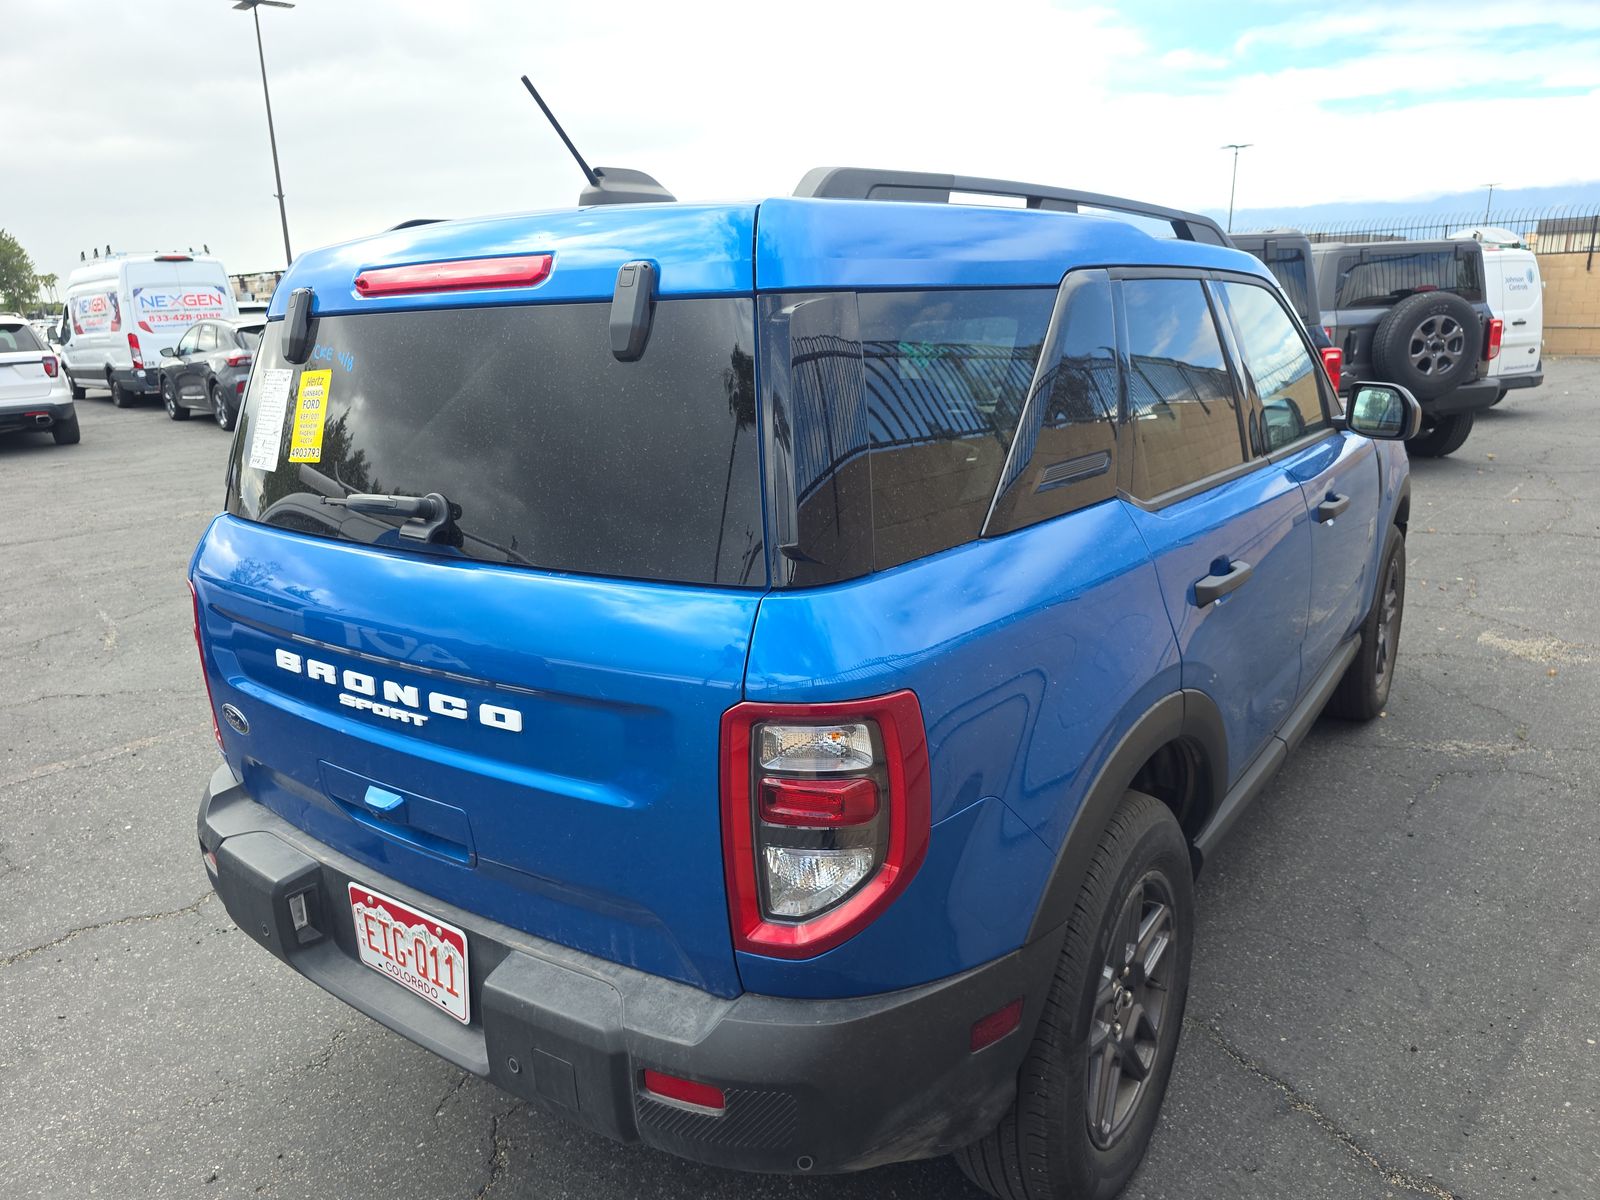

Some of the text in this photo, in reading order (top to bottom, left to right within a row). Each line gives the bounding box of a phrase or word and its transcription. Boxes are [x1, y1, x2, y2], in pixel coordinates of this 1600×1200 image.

[140, 293, 222, 308] NEXGEN
[305, 376, 324, 387] Hertz
[302, 399, 320, 410] FORD
[291, 447, 320, 458] 4903793
[275, 648, 523, 733] BRONCO
[339, 692, 429, 727] SPORT
[385, 961, 438, 999] COLORADO
